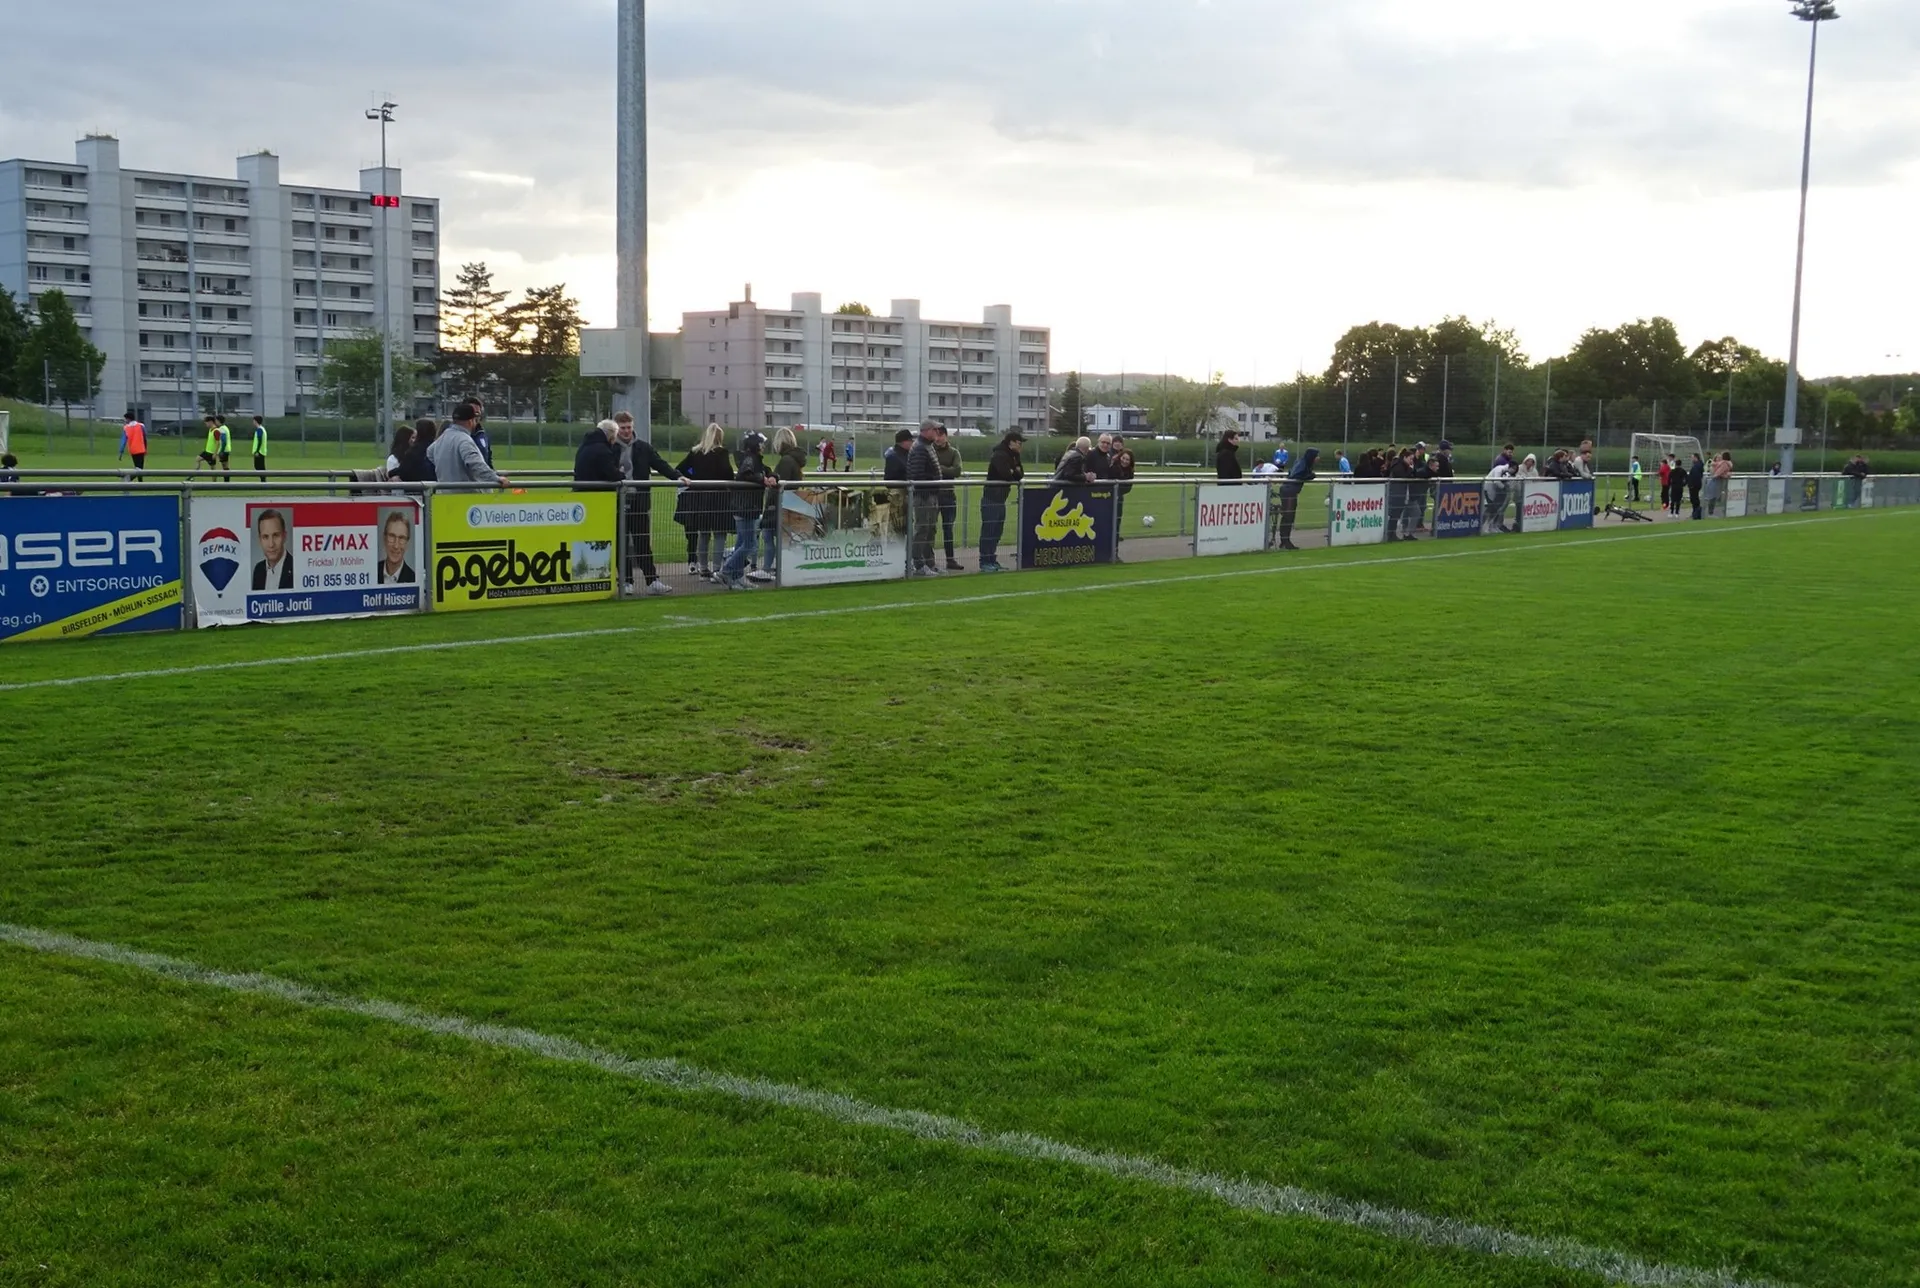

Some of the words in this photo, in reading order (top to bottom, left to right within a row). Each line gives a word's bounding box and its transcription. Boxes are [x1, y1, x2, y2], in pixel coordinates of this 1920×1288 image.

[1347, 497, 1383, 511] oberdorf
[485, 510, 516, 523] Vielen
[519, 509, 544, 522] Dank
[547, 508, 569, 521] Gebi
[1200, 502, 1264, 527] RAIFFEISEN
[203, 544, 237, 556] RE/MAX
[302, 533, 369, 551] RE/MAX
[804, 543, 842, 560] Traum
[845, 542, 883, 558] Garten
[308, 557, 334, 567] Fricktal
[340, 556, 364, 566] Möhlin
[1034, 545, 1095, 566] HEIZUNGEN
[303, 574, 320, 587] 061
[324, 573, 342, 587] 855
[344, 573, 357, 586] 98
[359, 572, 370, 585] 81
[436, 539, 571, 603] p.gebert
[56, 575, 163, 593] ENTSORGUNG
[251, 600, 284, 616] Cyrille
[286, 598, 313, 612] Jordi
[363, 594, 382, 607] Rolf
[384, 592, 416, 606] Hüsser
[62, 612, 108, 634] BIRSFELDEN
[113, 600, 143, 617] MÖHLIN
[146, 588, 178, 606] SISSACH
